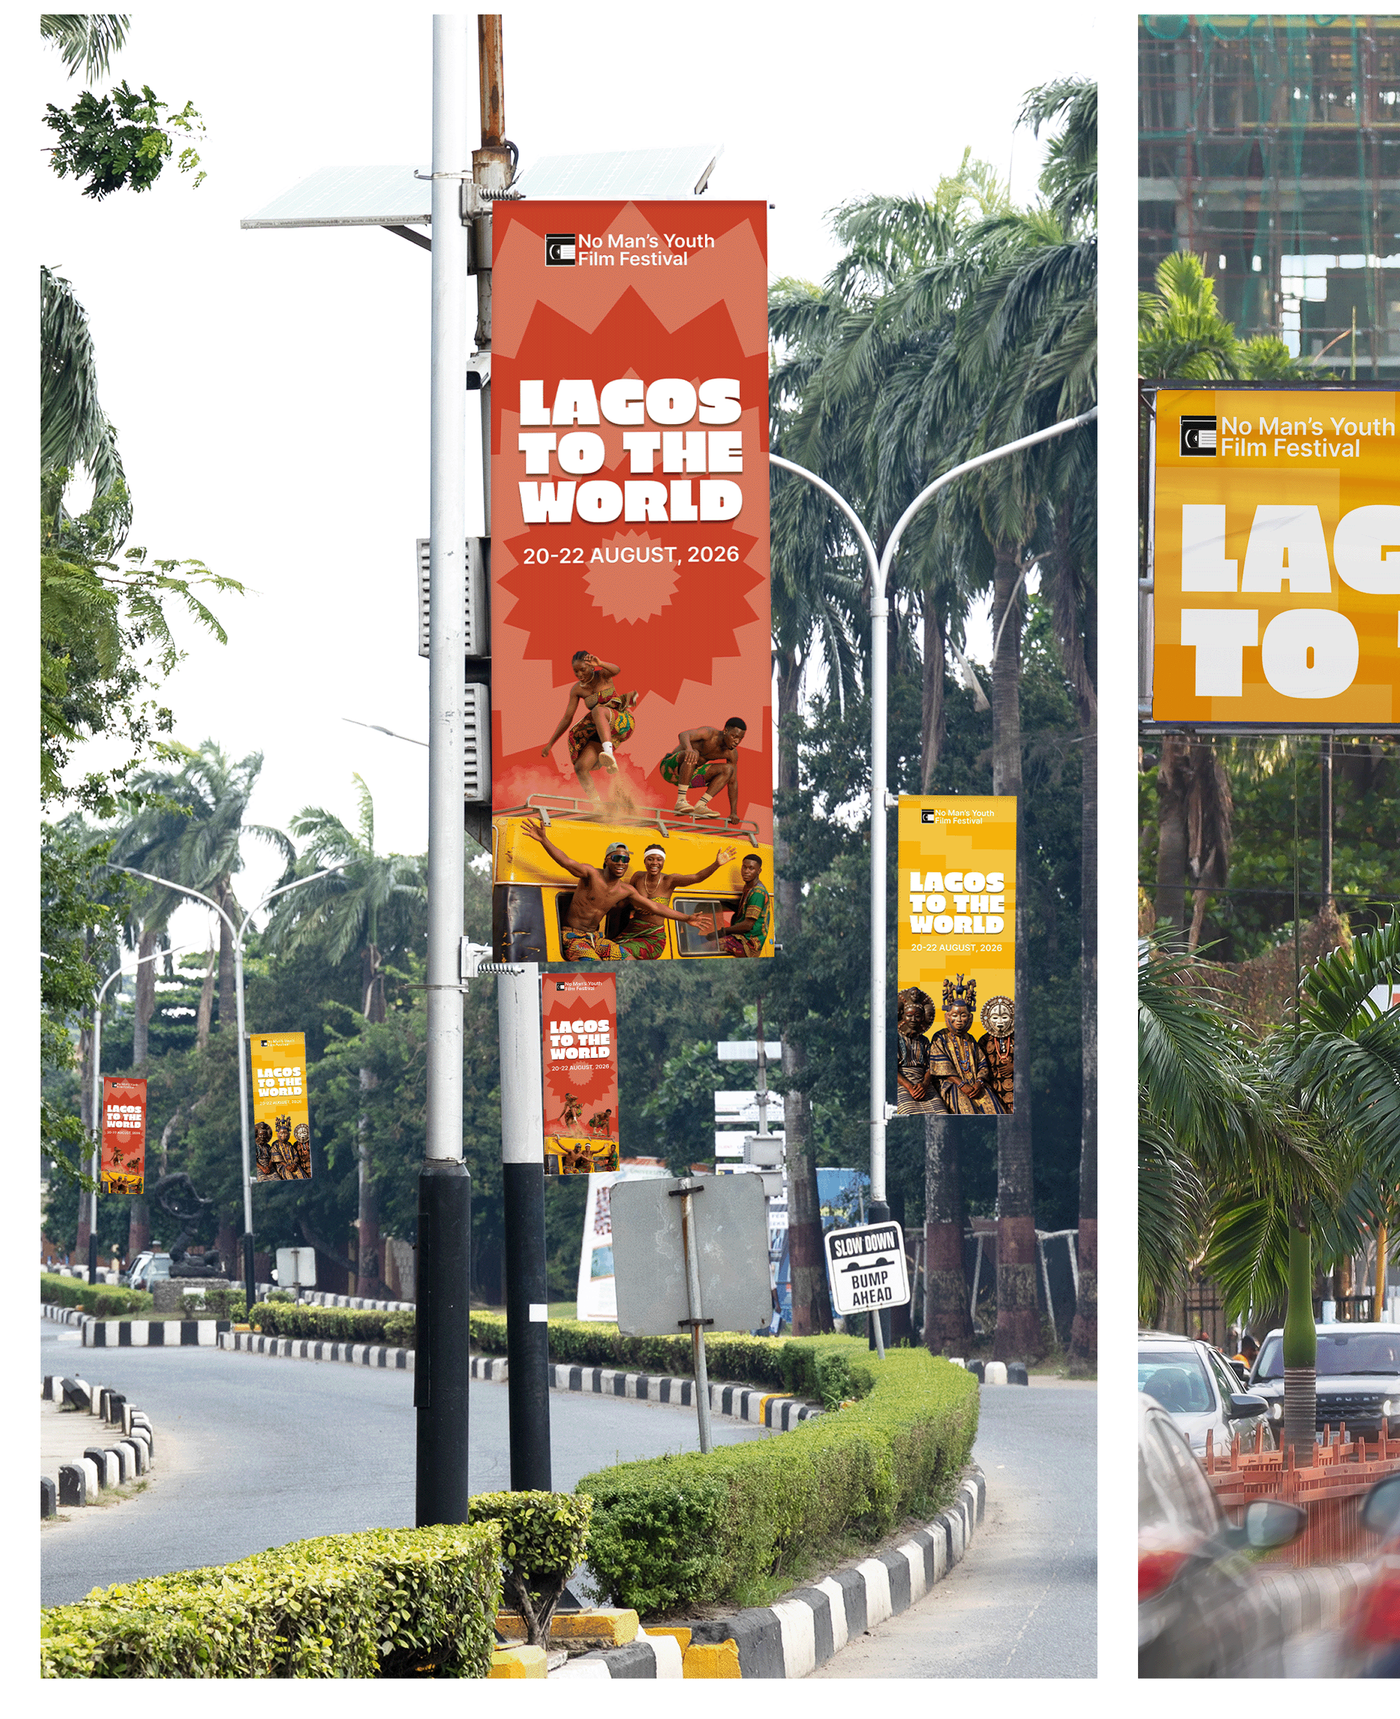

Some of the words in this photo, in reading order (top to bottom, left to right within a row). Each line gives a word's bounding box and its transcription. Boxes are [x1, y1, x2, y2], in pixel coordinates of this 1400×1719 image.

[578, 234, 602, 248] No
[608, 234, 658, 248] Man's
[664, 233, 714, 248] Youth
[578, 251, 614, 266] Film
[620, 250, 687, 266] Festival
[519, 378, 742, 425] LAGOS
[1221, 417, 1253, 437] No
[1259, 417, 1323, 436] Man's
[1329, 417, 1395, 437] Youth
[518, 431, 605, 474] TO
[623, 430, 743, 473] THE
[1221, 438, 1267, 457] Film
[1273, 437, 1361, 458] Festival
[518, 479, 743, 523] WORLD
[523, 548, 584, 564] 20-22
[589, 546, 682, 566] AUGUST,
[687, 546, 739, 562] 2026
[1180, 608, 1359, 699] TO
[935, 809, 946, 817] No
[972, 809, 995, 817] Youth
[953, 817, 983, 825] Festival
[909, 872, 1005, 893] LAGOS
[909, 894, 946, 914] TO
[953, 895, 1004, 914] THE
[909, 915, 1004, 935] WORLD
[911, 943, 937, 952] 20-22
[939, 943, 978, 953] AUGUST,
[980, 943, 1003, 952] 2026
[550, 1019, 610, 1034] LAGOS
[550, 1034, 574, 1047] TO
[578, 1033, 610, 1046] THE
[550, 1047, 610, 1060] WORLD
[257, 1067, 302, 1078] LAGOS
[258, 1079, 275, 1088] TO
[278, 1077, 302, 1087] THE
[258, 1087, 302, 1098] WORLD
[107, 1105, 142, 1114] LAGOS
[107, 1113, 121, 1121] TO
[107, 1121, 142, 1129] WORLD
[834, 1236, 863, 1257] SLOW
[864, 1231, 895, 1252] DOWN
[851, 1271, 888, 1290] BUMP
[852, 1286, 893, 1306] AHEAD
